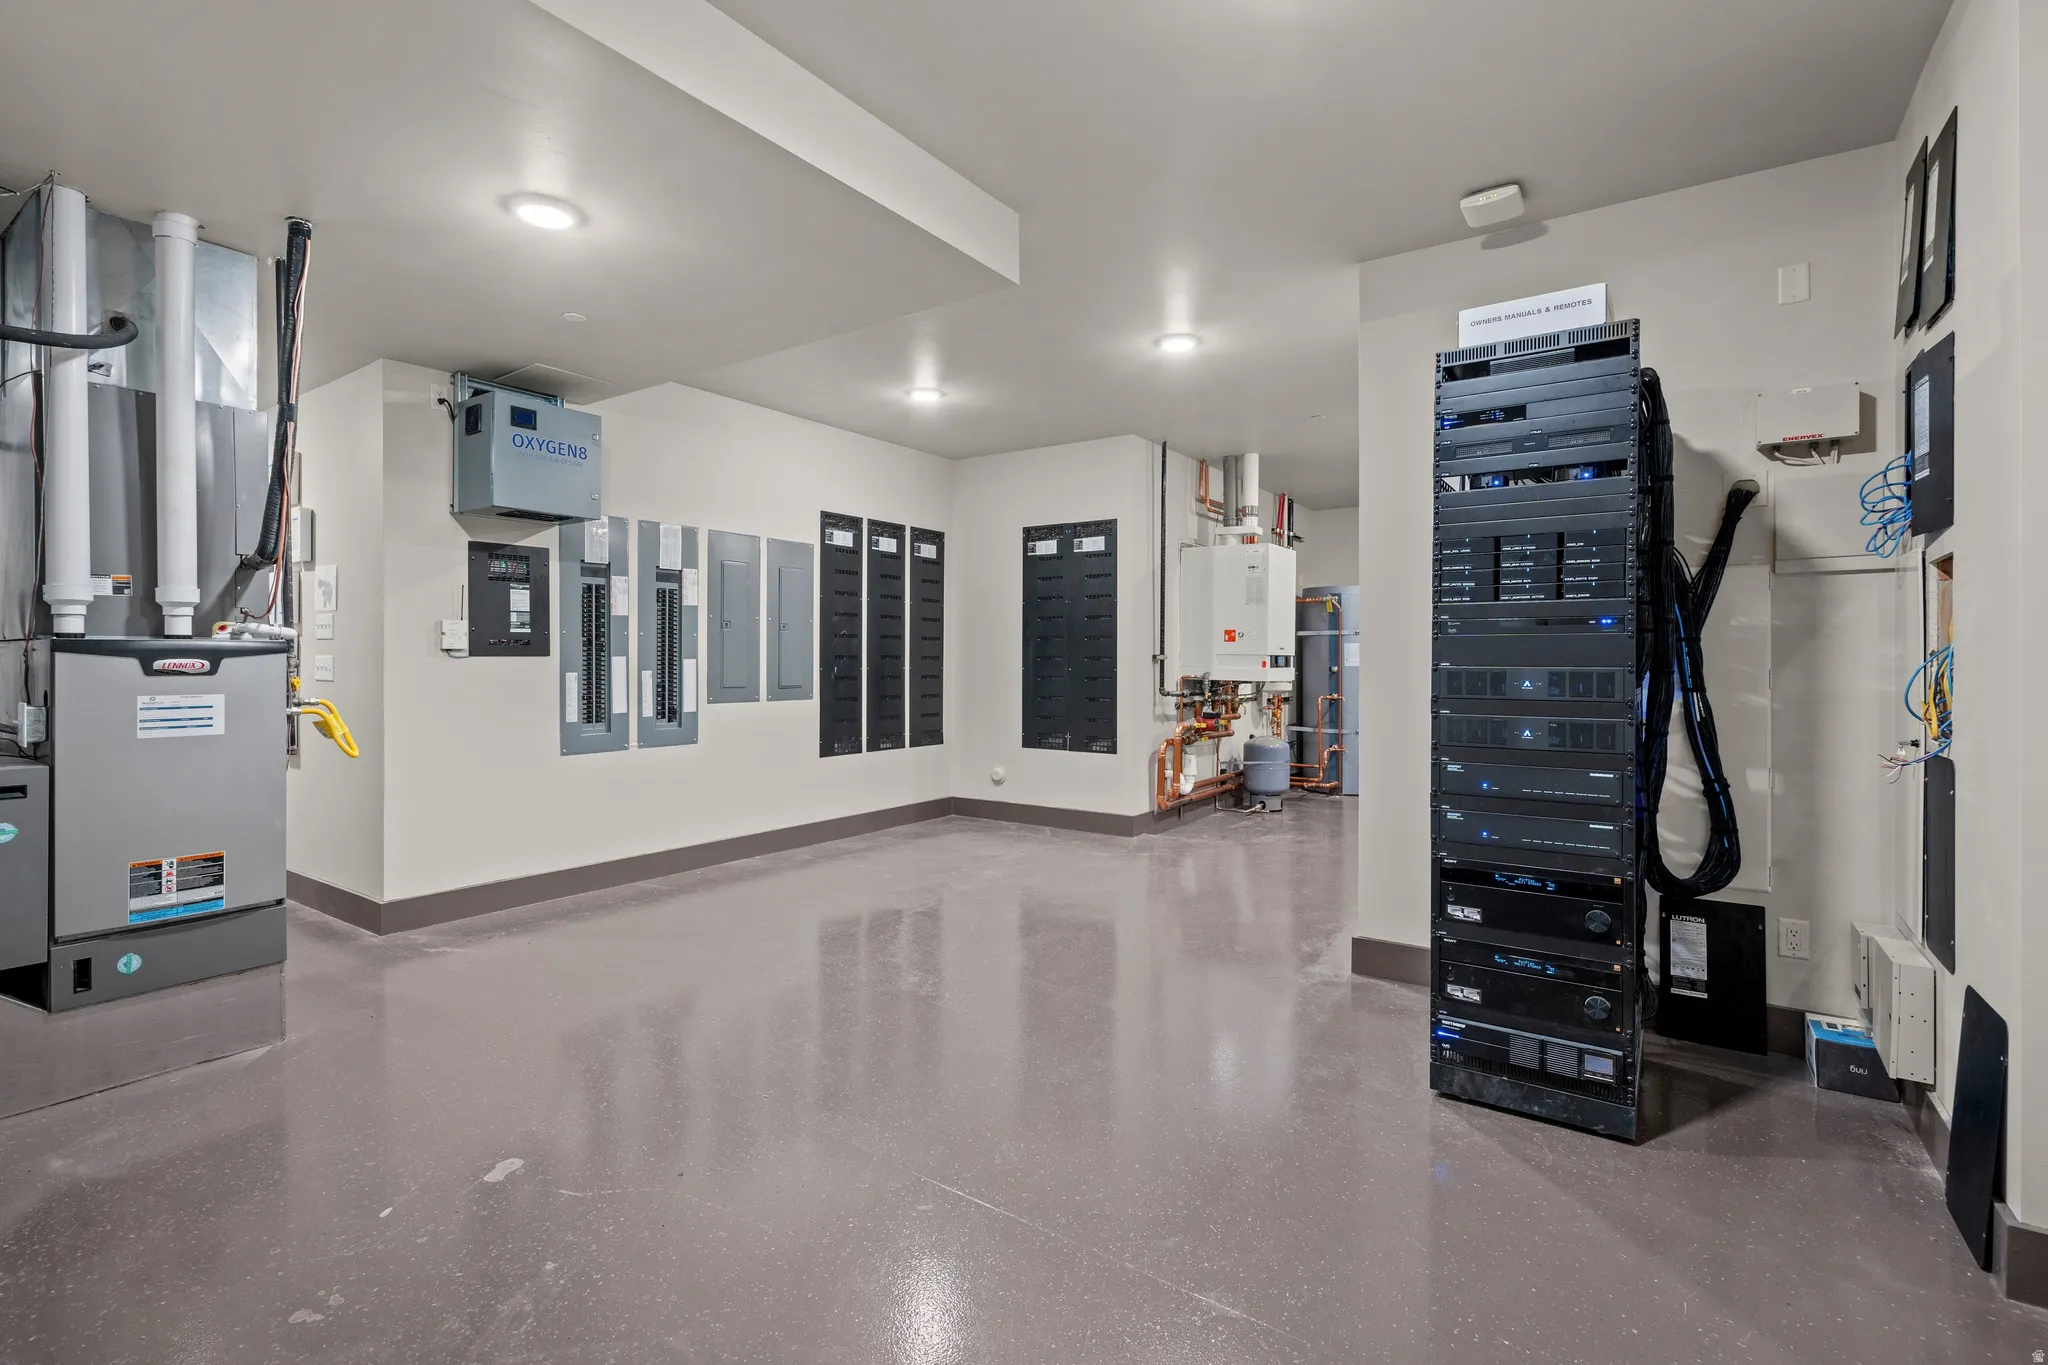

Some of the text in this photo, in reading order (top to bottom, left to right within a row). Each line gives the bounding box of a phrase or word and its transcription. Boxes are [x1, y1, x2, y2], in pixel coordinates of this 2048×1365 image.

[1470, 315, 1502, 327] OWNERS
[1504, 308, 1542, 321] MANUALS
[1553, 298, 1593, 312] REMOTES
[1782, 433, 1824, 442] ENERVEX
[512, 433, 588, 460] OXYGEN8
[1671, 914, 1706, 924] LUTRON
[1849, 1064, 1868, 1075] ring
